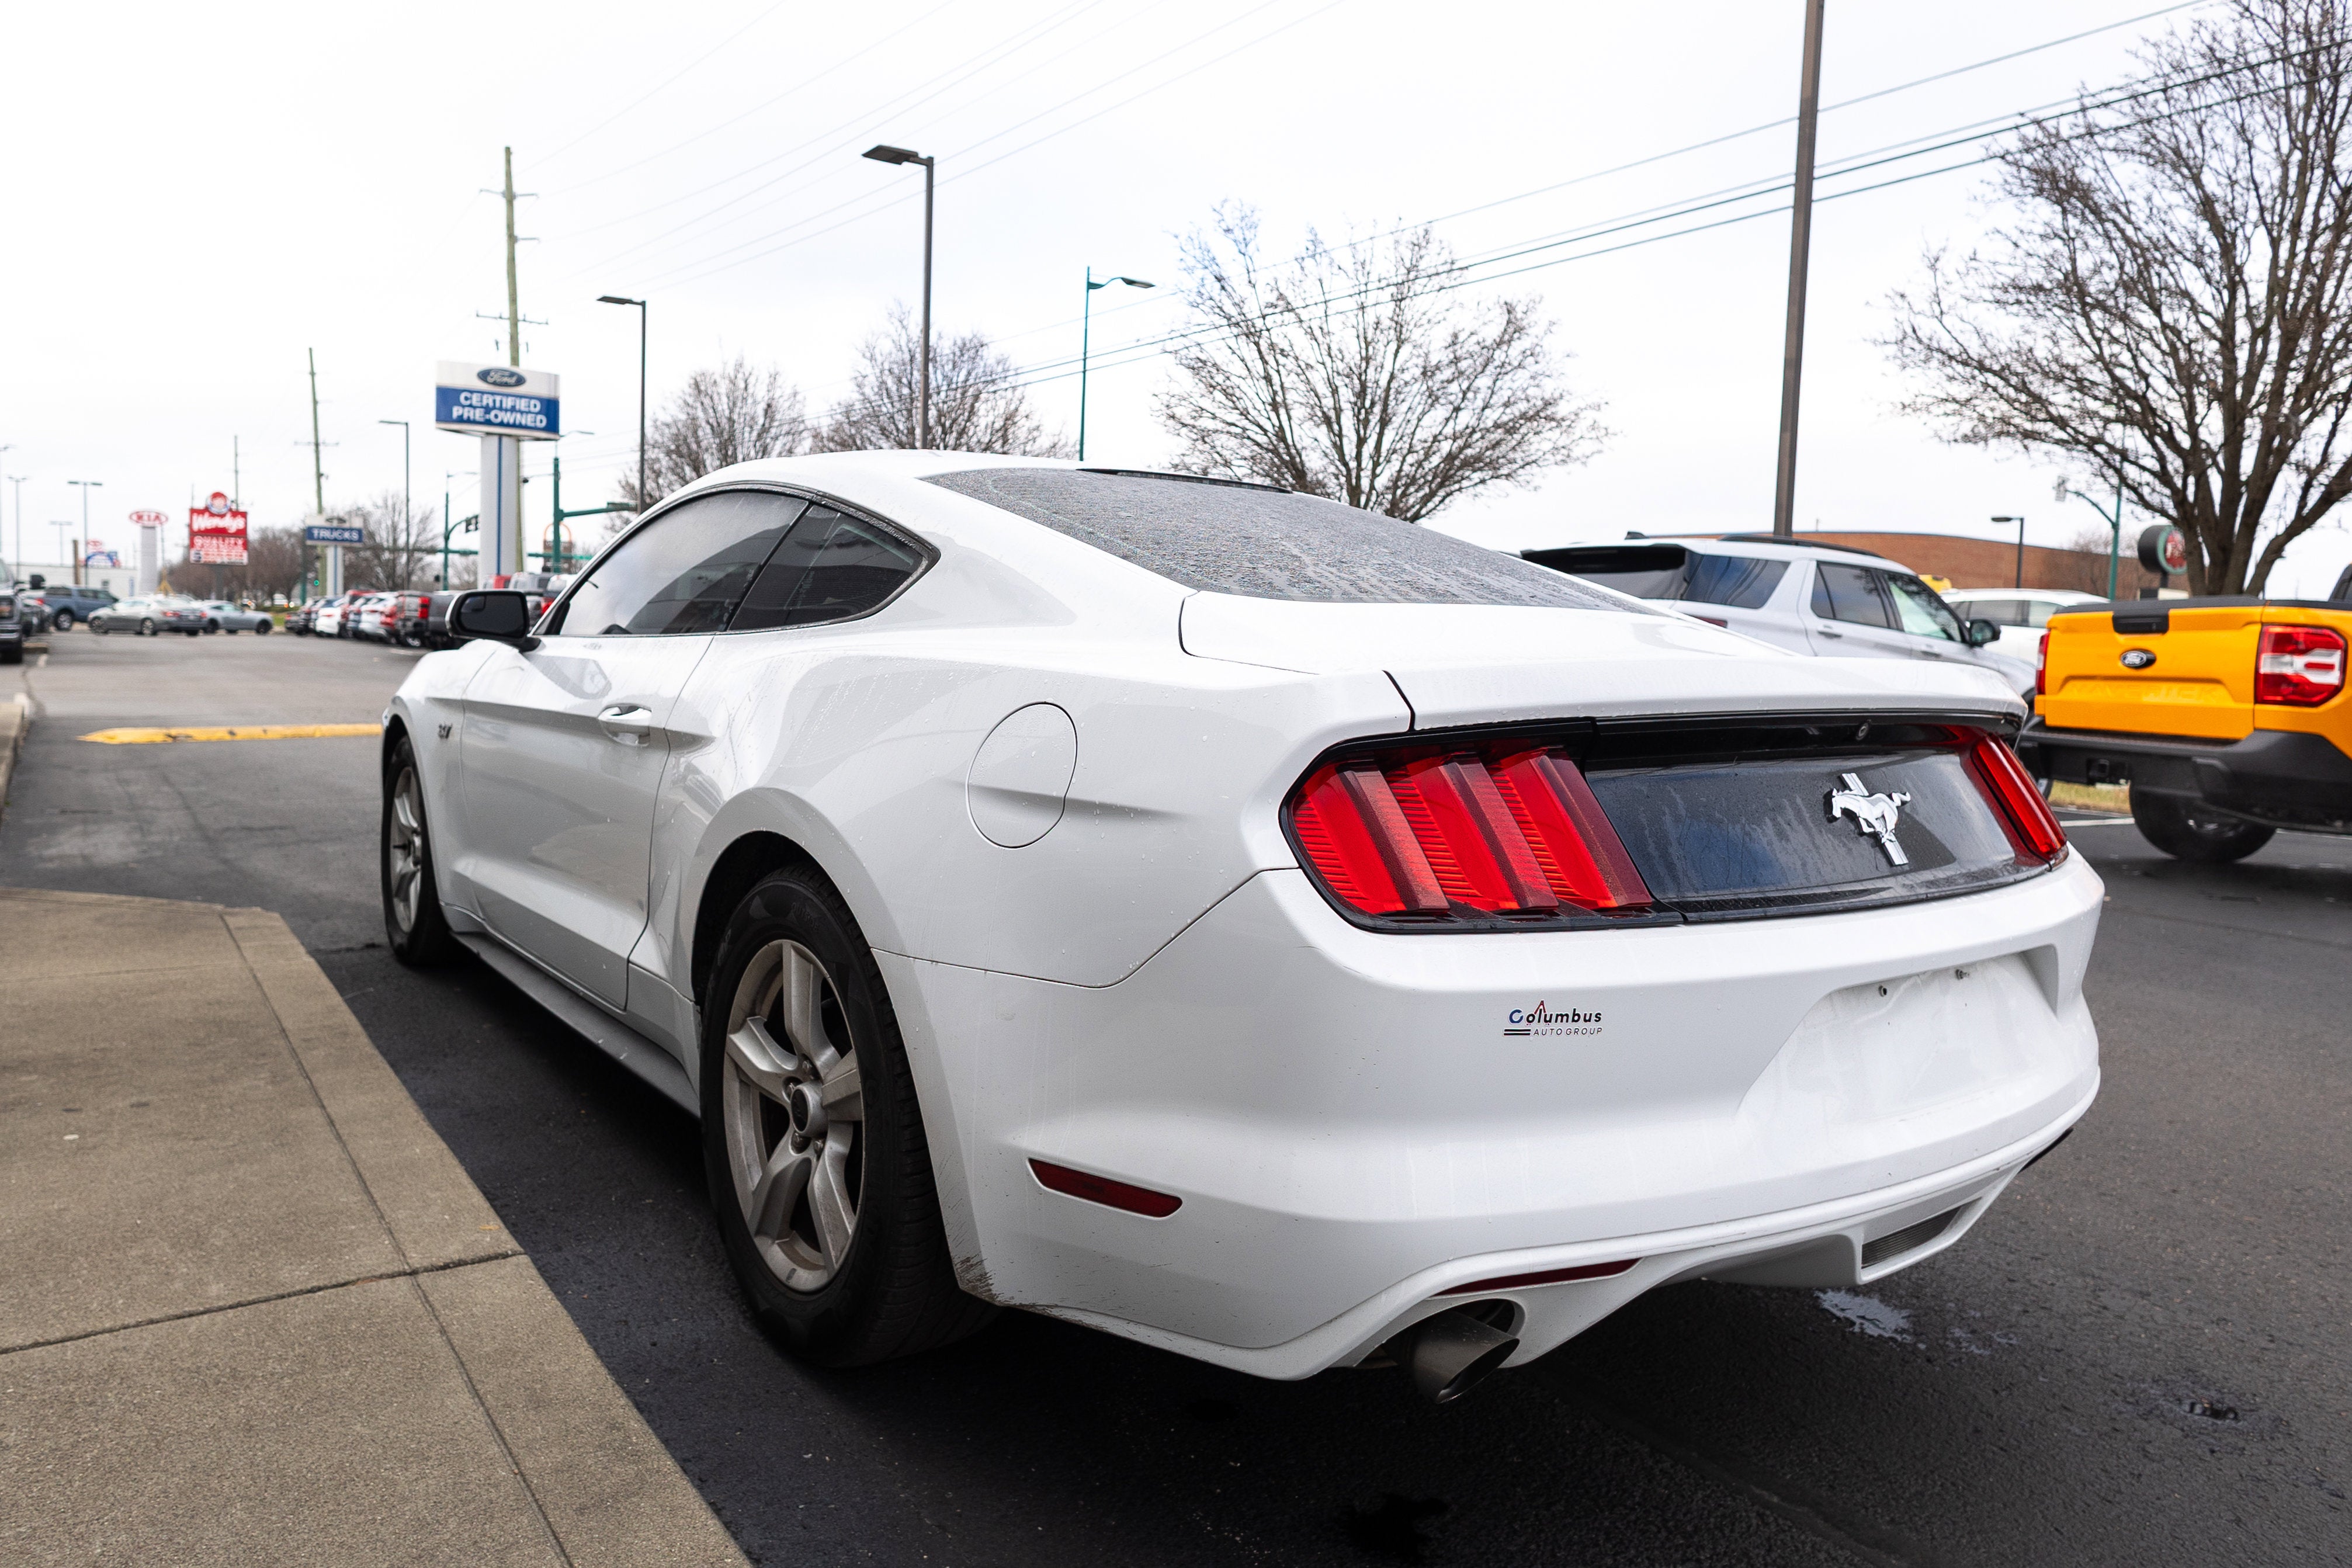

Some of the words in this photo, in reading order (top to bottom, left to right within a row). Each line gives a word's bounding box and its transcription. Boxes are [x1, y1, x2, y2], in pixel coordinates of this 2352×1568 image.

[459, 391, 542, 413] CERTIFIED
[452, 405, 547, 428] PRE-OWNED
[136, 513, 162, 522] KIA
[192, 512, 246, 533] Wendy's
[311, 528, 359, 542] TRUCKS
[1509, 1007, 1602, 1024] Columbus
